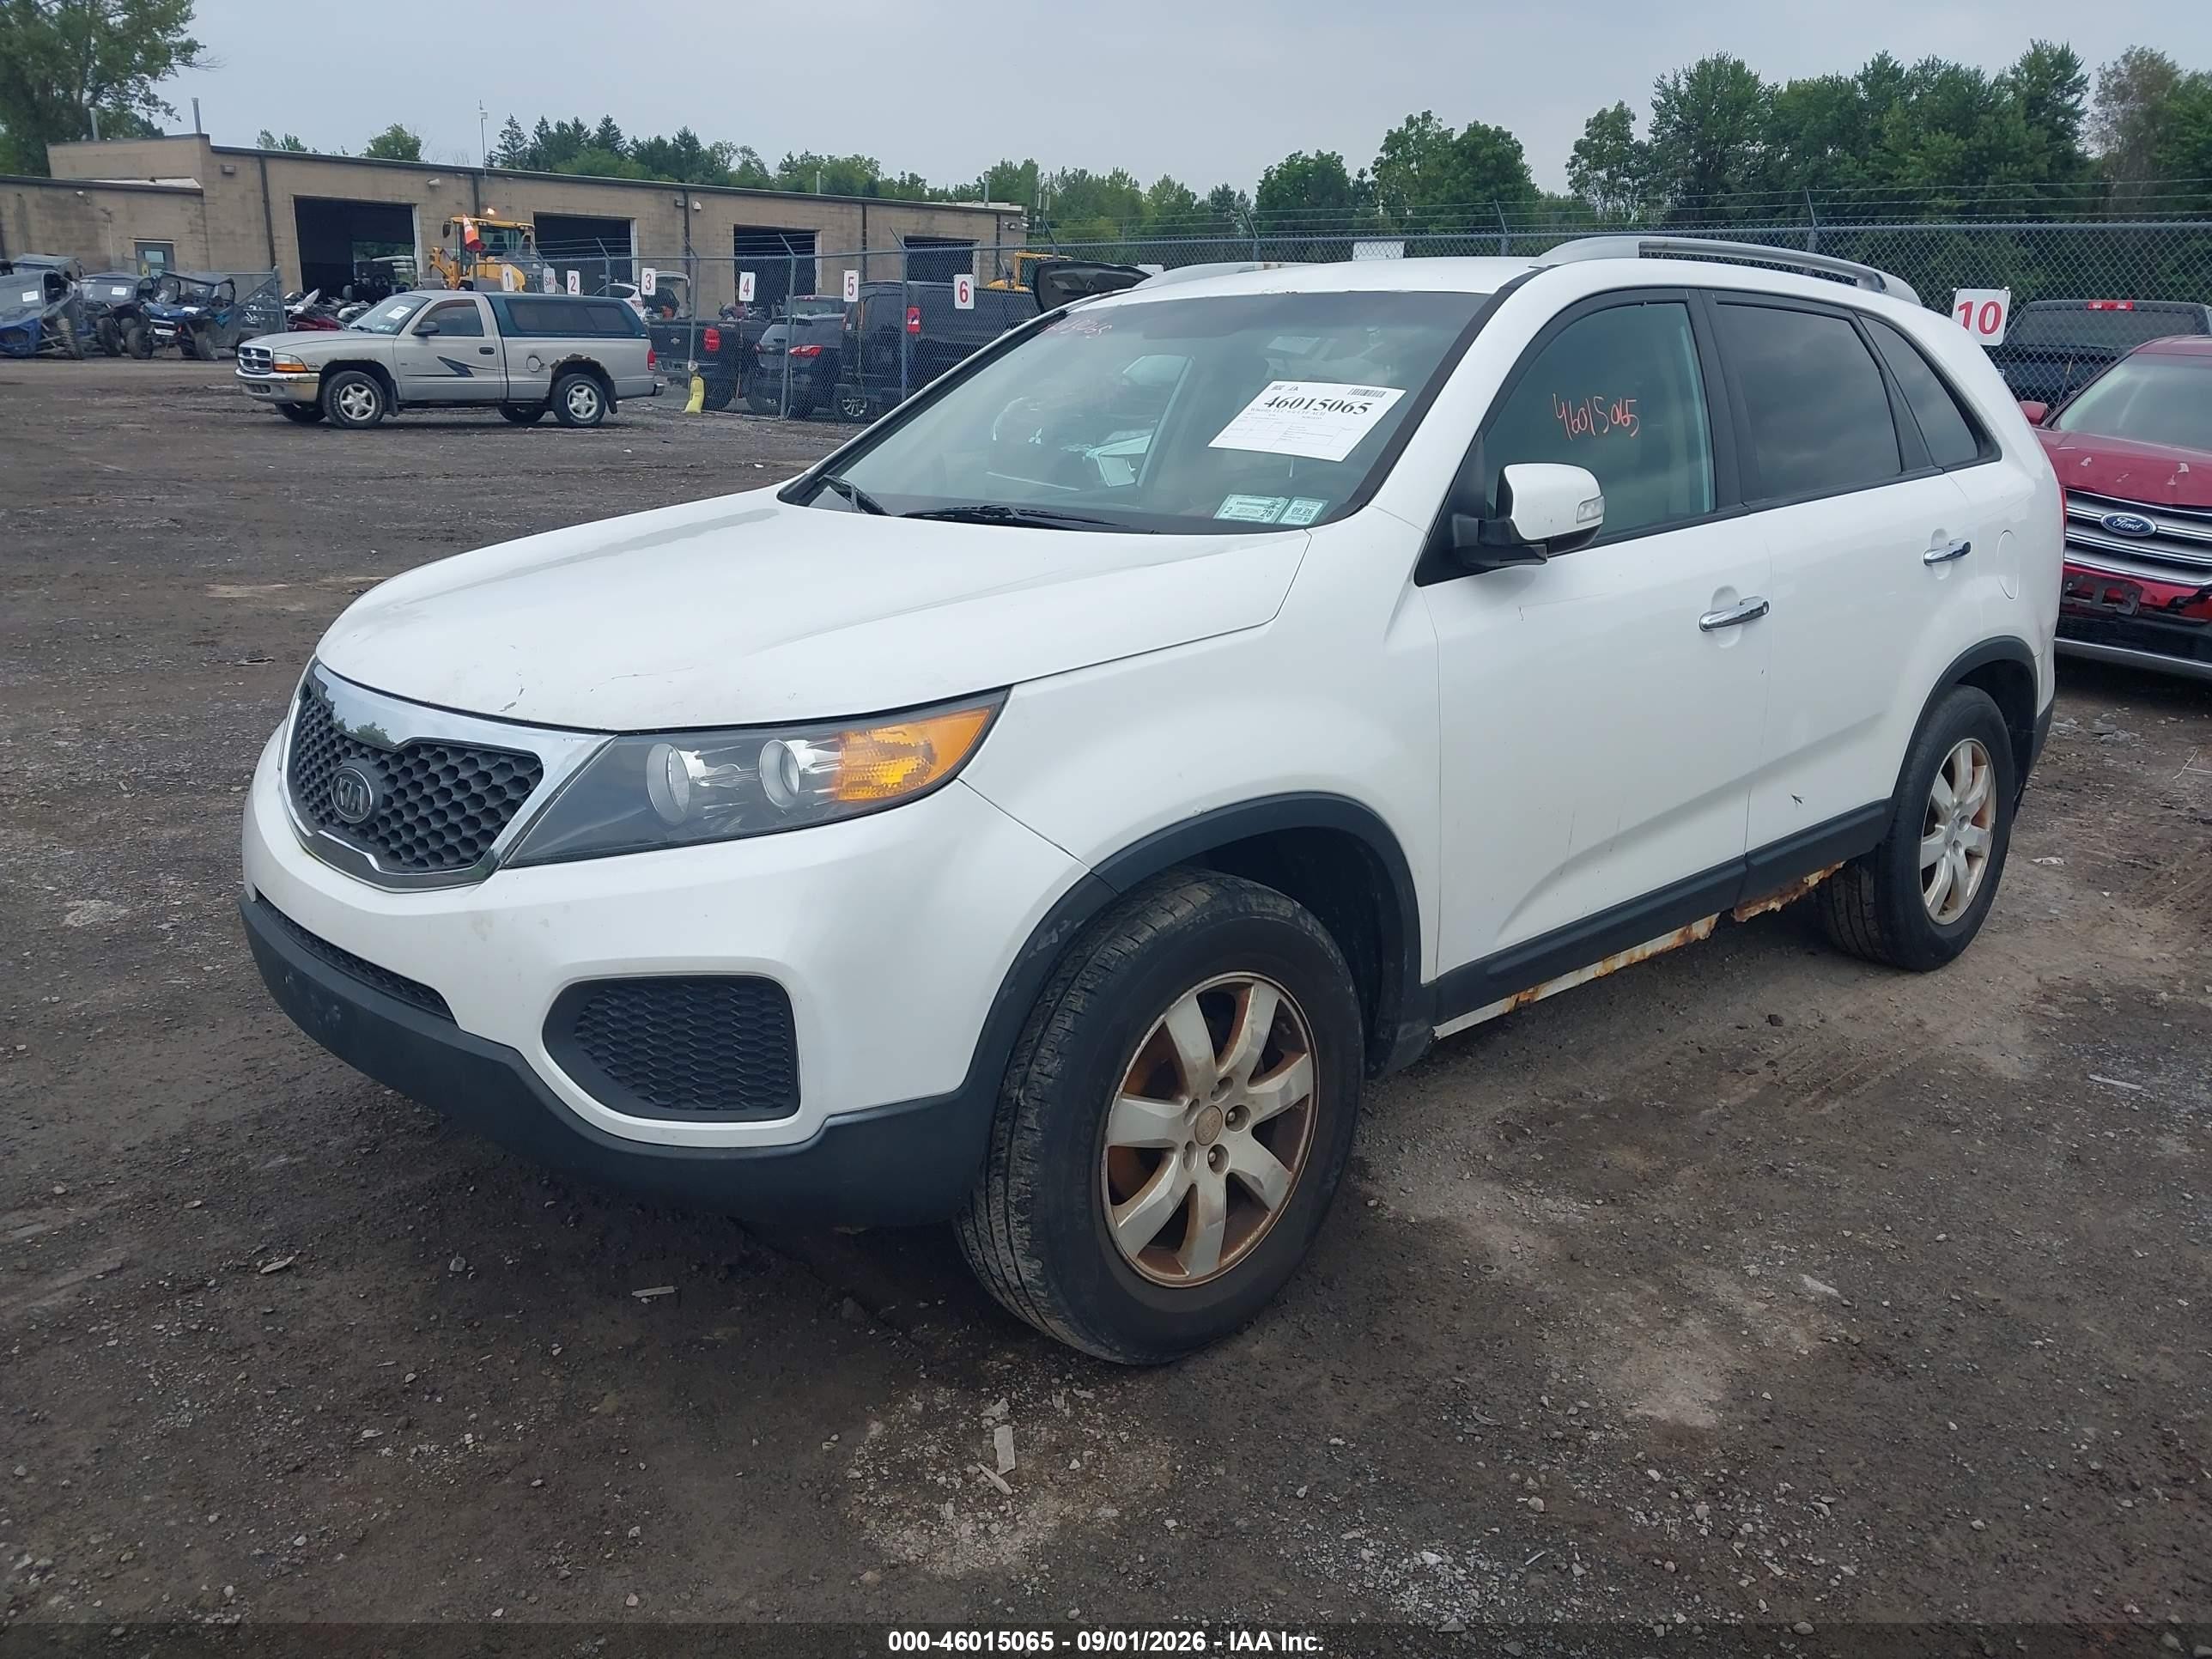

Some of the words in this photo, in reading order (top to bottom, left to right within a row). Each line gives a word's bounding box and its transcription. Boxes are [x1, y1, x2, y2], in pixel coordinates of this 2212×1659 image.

[504, 271, 510, 288] 1
[570, 275, 576, 292] 2
[645, 273, 652, 290] 3
[742, 277, 750, 296] 4
[847, 276, 854, 296] 5
[958, 280, 969, 303] 6
[1957, 300, 2002, 335] 10
[1263, 395, 1375, 416] 46015065
[1553, 392, 1640, 441] 46015065
[2112, 516, 2143, 532] Ford
